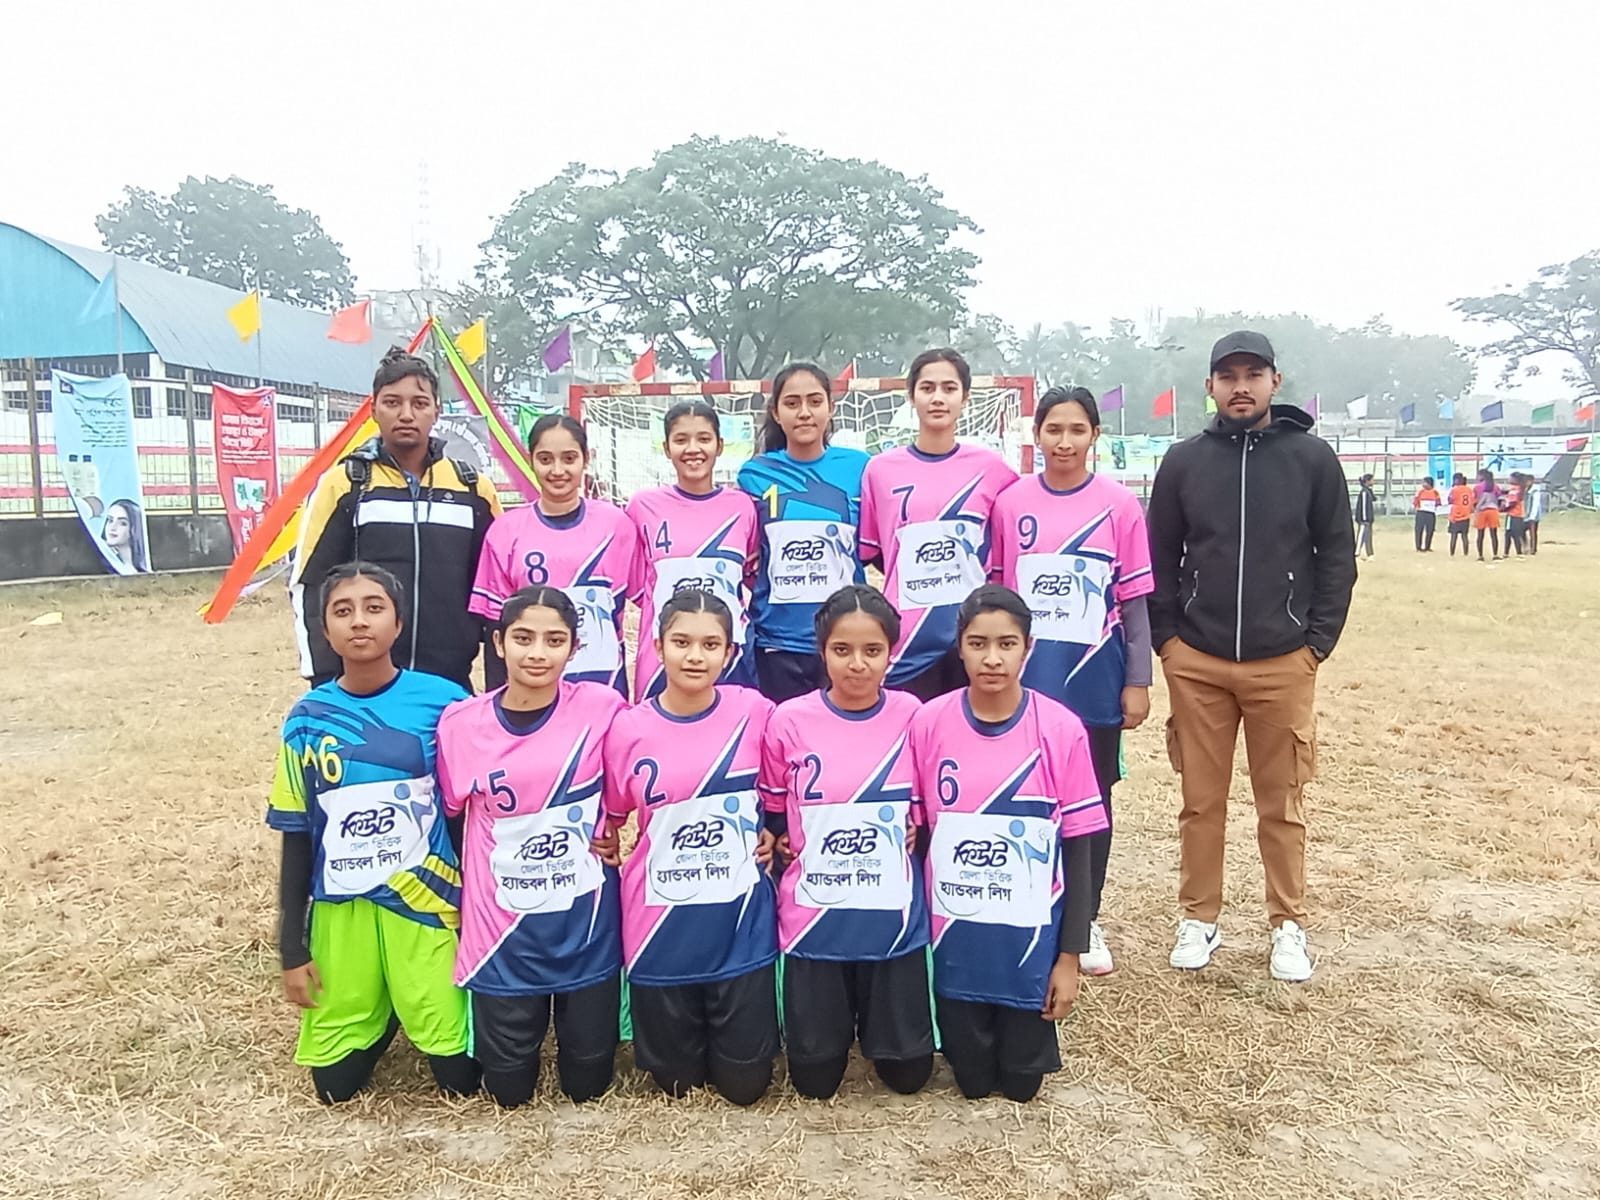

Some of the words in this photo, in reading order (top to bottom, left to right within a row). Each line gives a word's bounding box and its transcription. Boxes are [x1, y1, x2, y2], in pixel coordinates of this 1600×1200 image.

[762, 483, 779, 519] 1
[892, 485, 914, 522] 7
[1462, 495, 1469, 506] 8
[643, 520, 672, 559] 14
[1018, 515, 1038, 550] 9
[524, 551, 549, 586] 8
[634, 758, 667, 807] 2
[938, 759, 959, 807] 6
